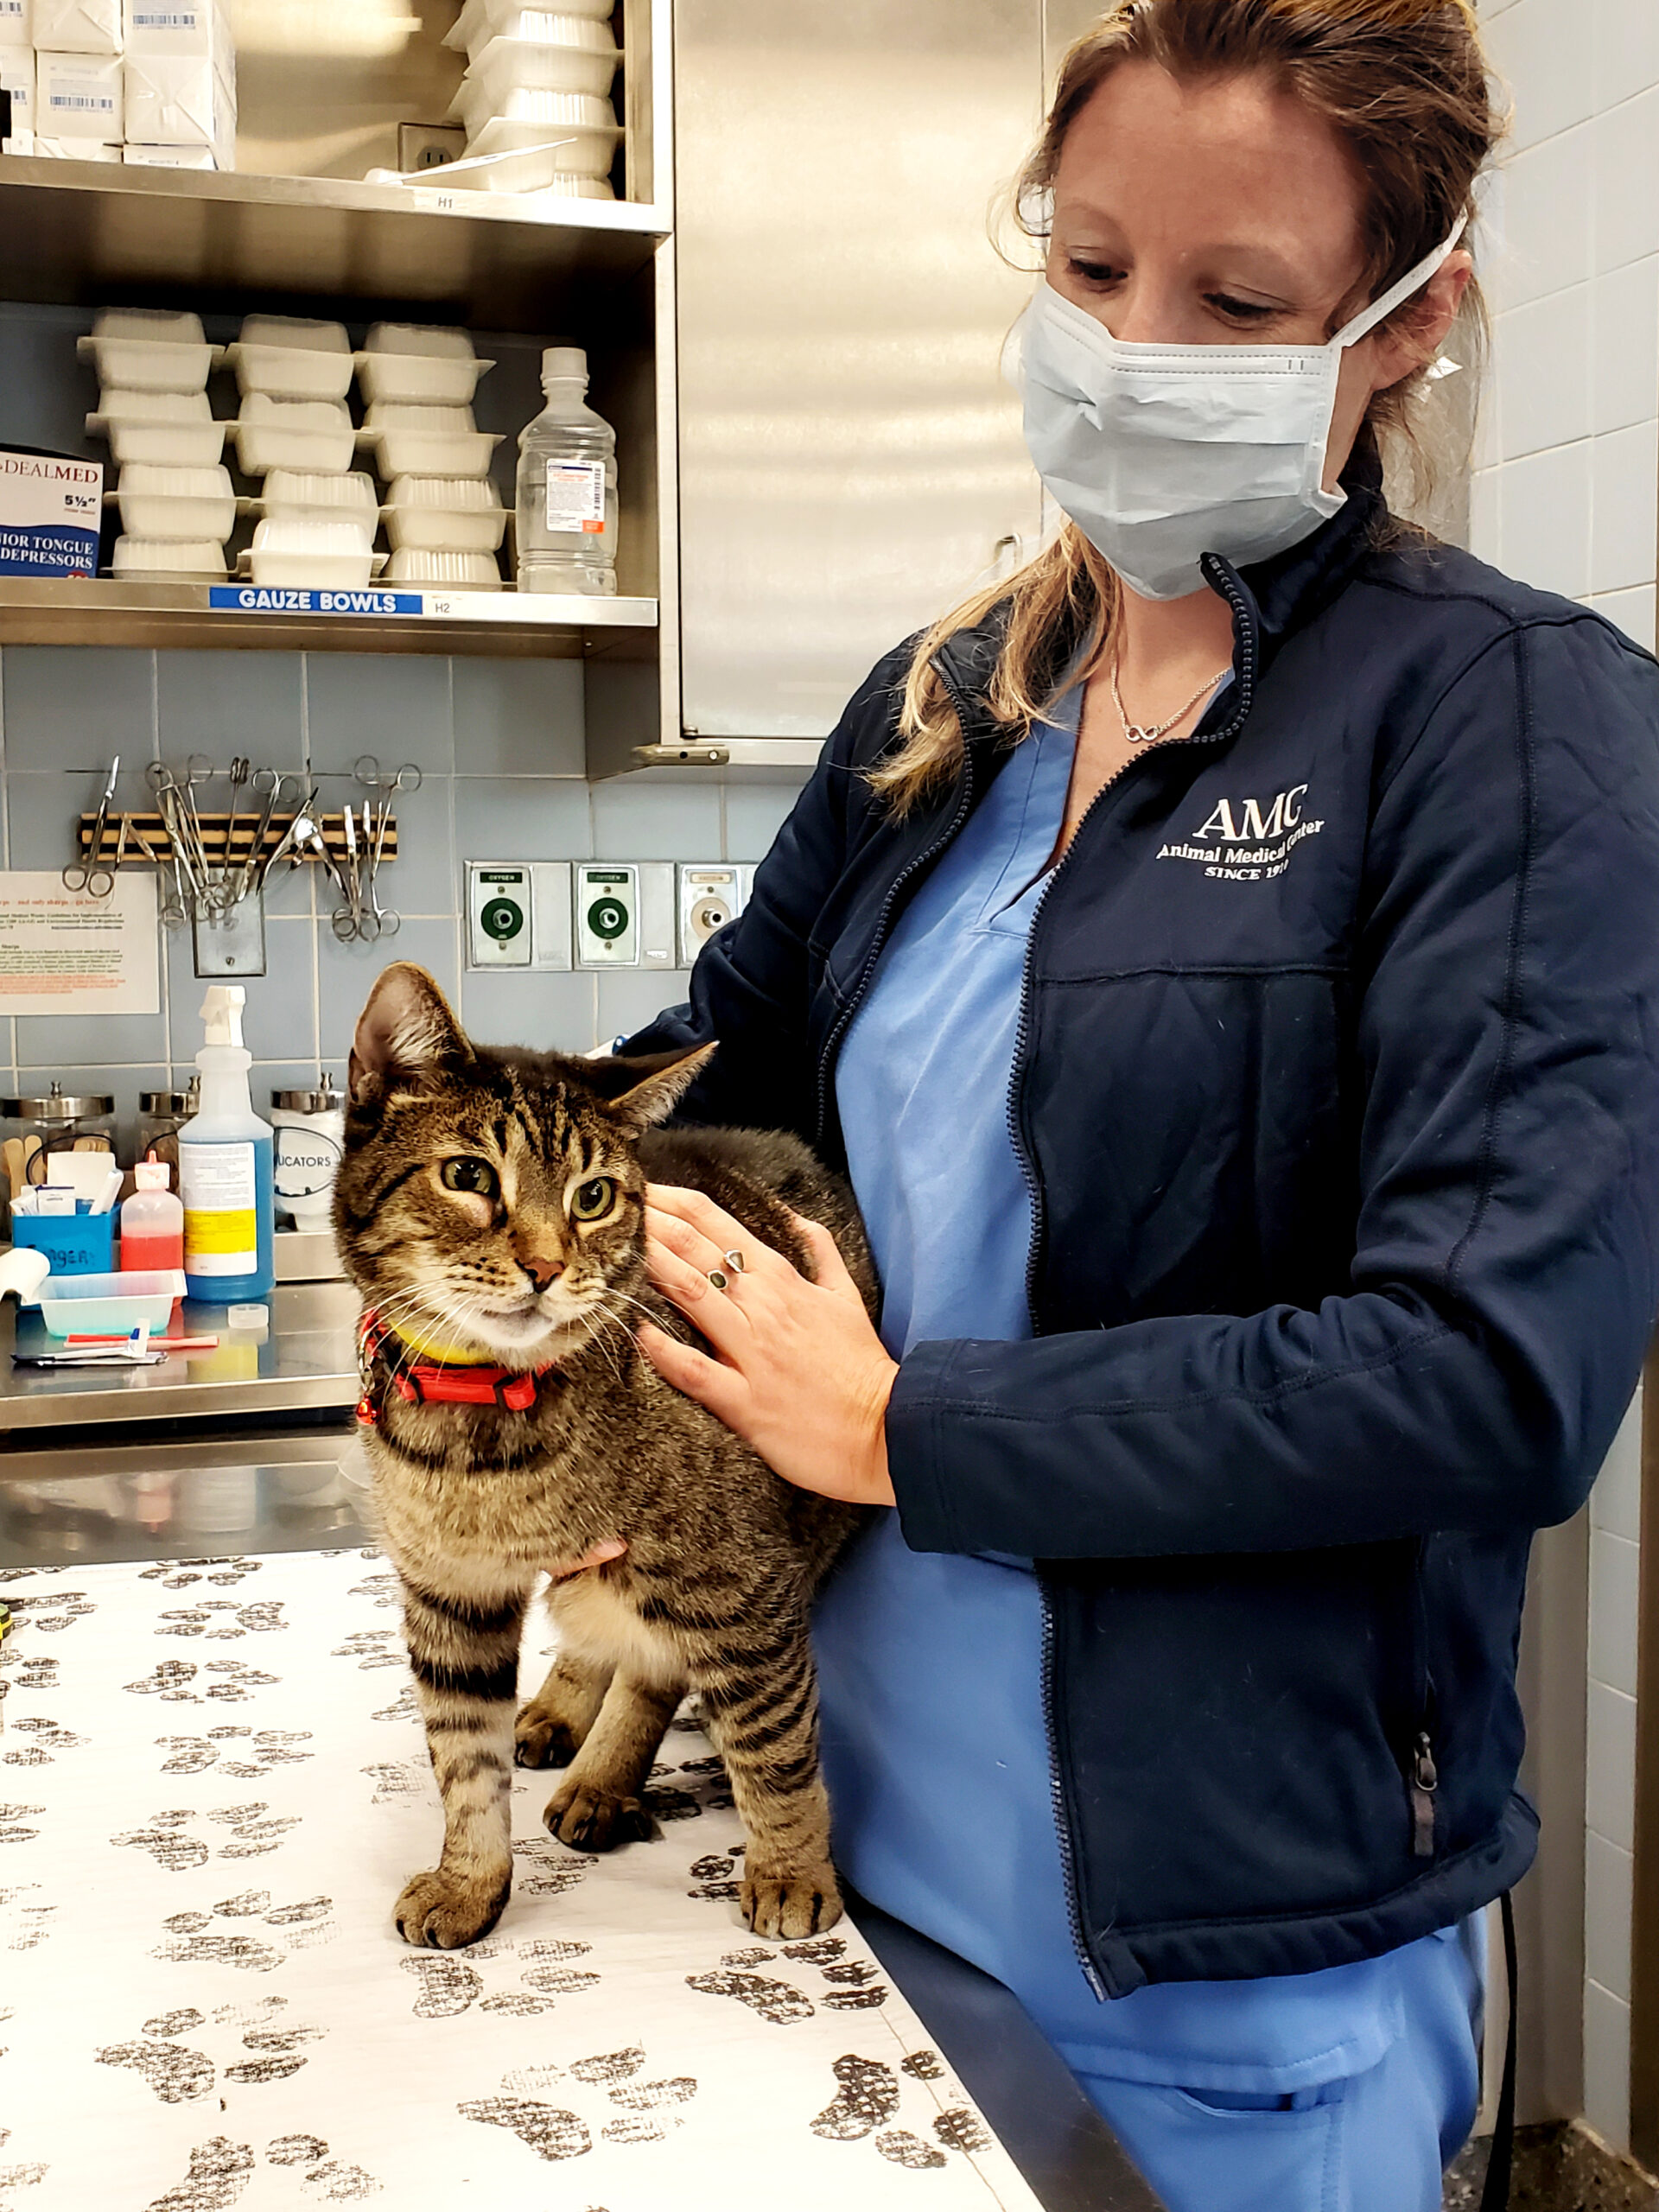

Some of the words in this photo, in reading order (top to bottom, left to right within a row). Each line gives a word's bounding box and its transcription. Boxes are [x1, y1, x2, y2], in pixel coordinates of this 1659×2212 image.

[437, 196, 453, 208] H1
[4, 460, 99, 483] DEALMED
[0, 532, 29, 548] IOR
[33, 536, 94, 556] TONGUE
[1, 547, 93, 570] DEPRESSORS
[238, 589, 311, 610] GAUZE
[320, 592, 397, 613] BOWLS
[435, 602, 450, 613] H2
[1192, 783, 1308, 842] AMC
[1155, 842, 1221, 863] Animal
[1224, 842, 1287, 864] Medical
[1204, 866, 1262, 881] SINCE
[277, 1155, 332, 1167] LICATORS
